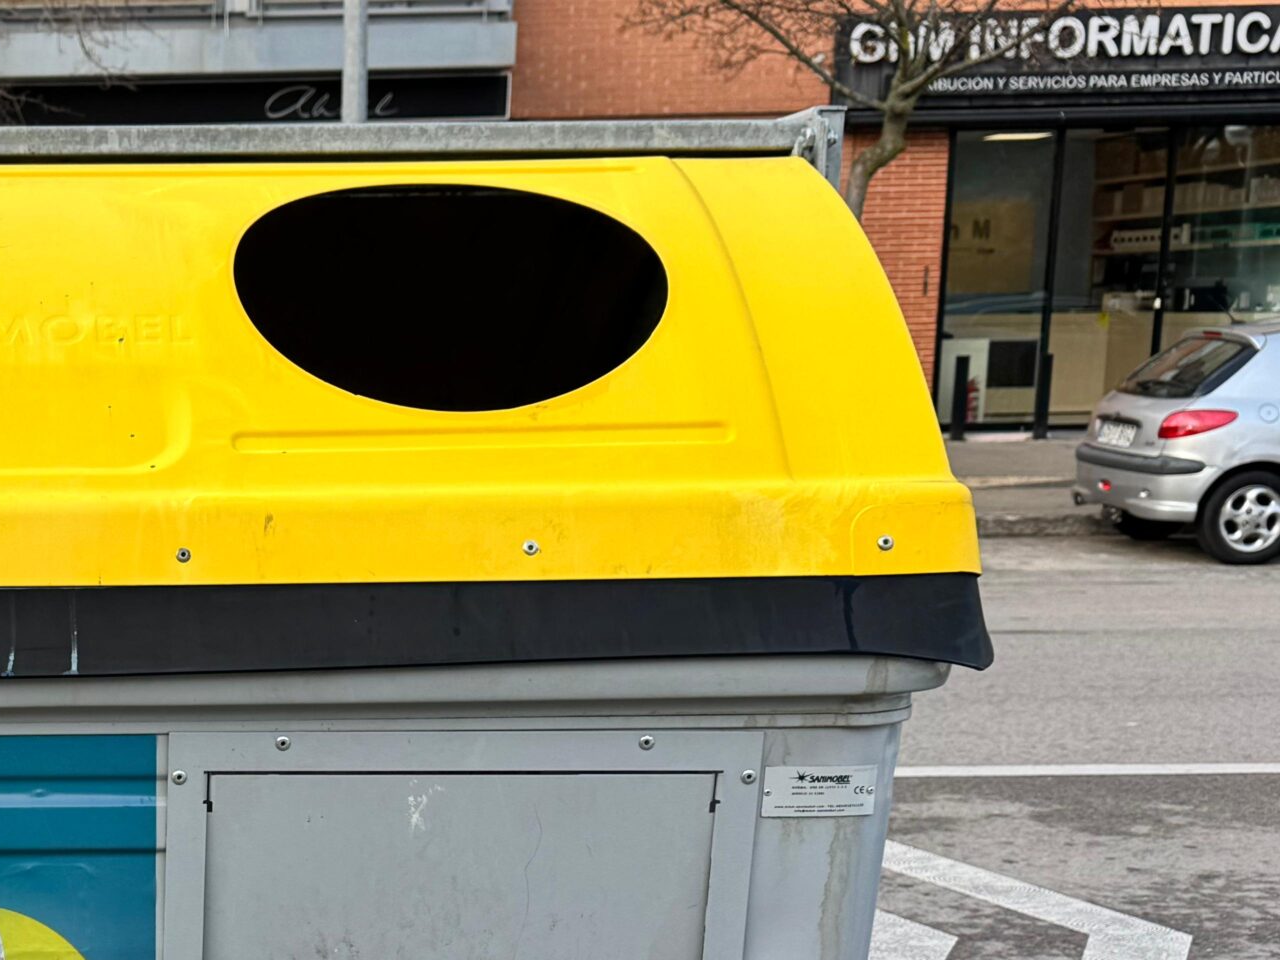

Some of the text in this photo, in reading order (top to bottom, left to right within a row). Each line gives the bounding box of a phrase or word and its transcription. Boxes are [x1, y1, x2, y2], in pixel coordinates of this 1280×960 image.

[850, 20, 956, 63] GM
[996, 75, 1007, 89] Y
[1009, 74, 1086, 89] SERVICIOS
[1089, 74, 1128, 88] PARA
[1130, 72, 1210, 87] EMPRESAS
[1213, 72, 1223, 84] Y
[808, 774, 851, 784] SANIMOBEL
